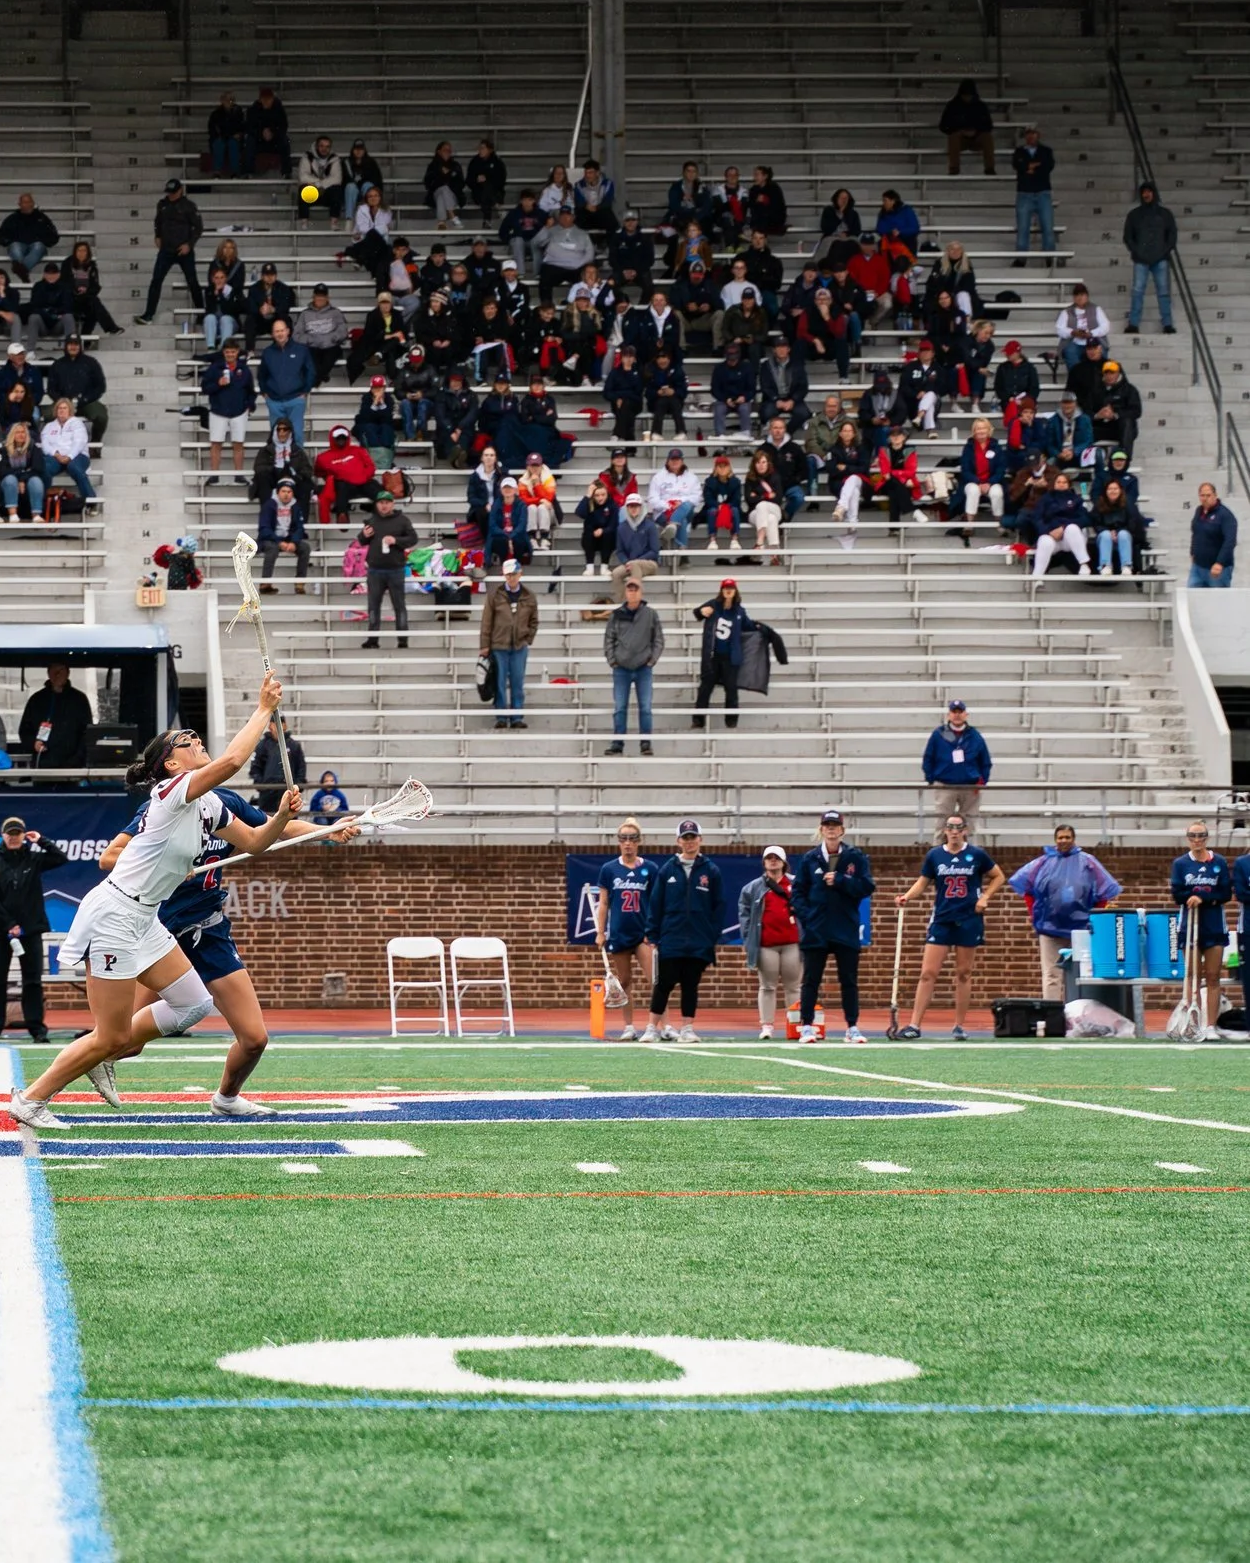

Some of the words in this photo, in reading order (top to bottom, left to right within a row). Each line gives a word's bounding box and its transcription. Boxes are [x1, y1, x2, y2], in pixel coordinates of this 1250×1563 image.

[936, 863, 976, 876] Richmond
[612, 877, 650, 891] Richmond
[944, 876, 968, 899] 25
[224, 881, 291, 919] ACK
[621, 890, 641, 913] 21
[1116, 916, 1126, 961] POWERADE
[1169, 916, 1179, 961] POWERADE
[103, 954, 118, 971] P
